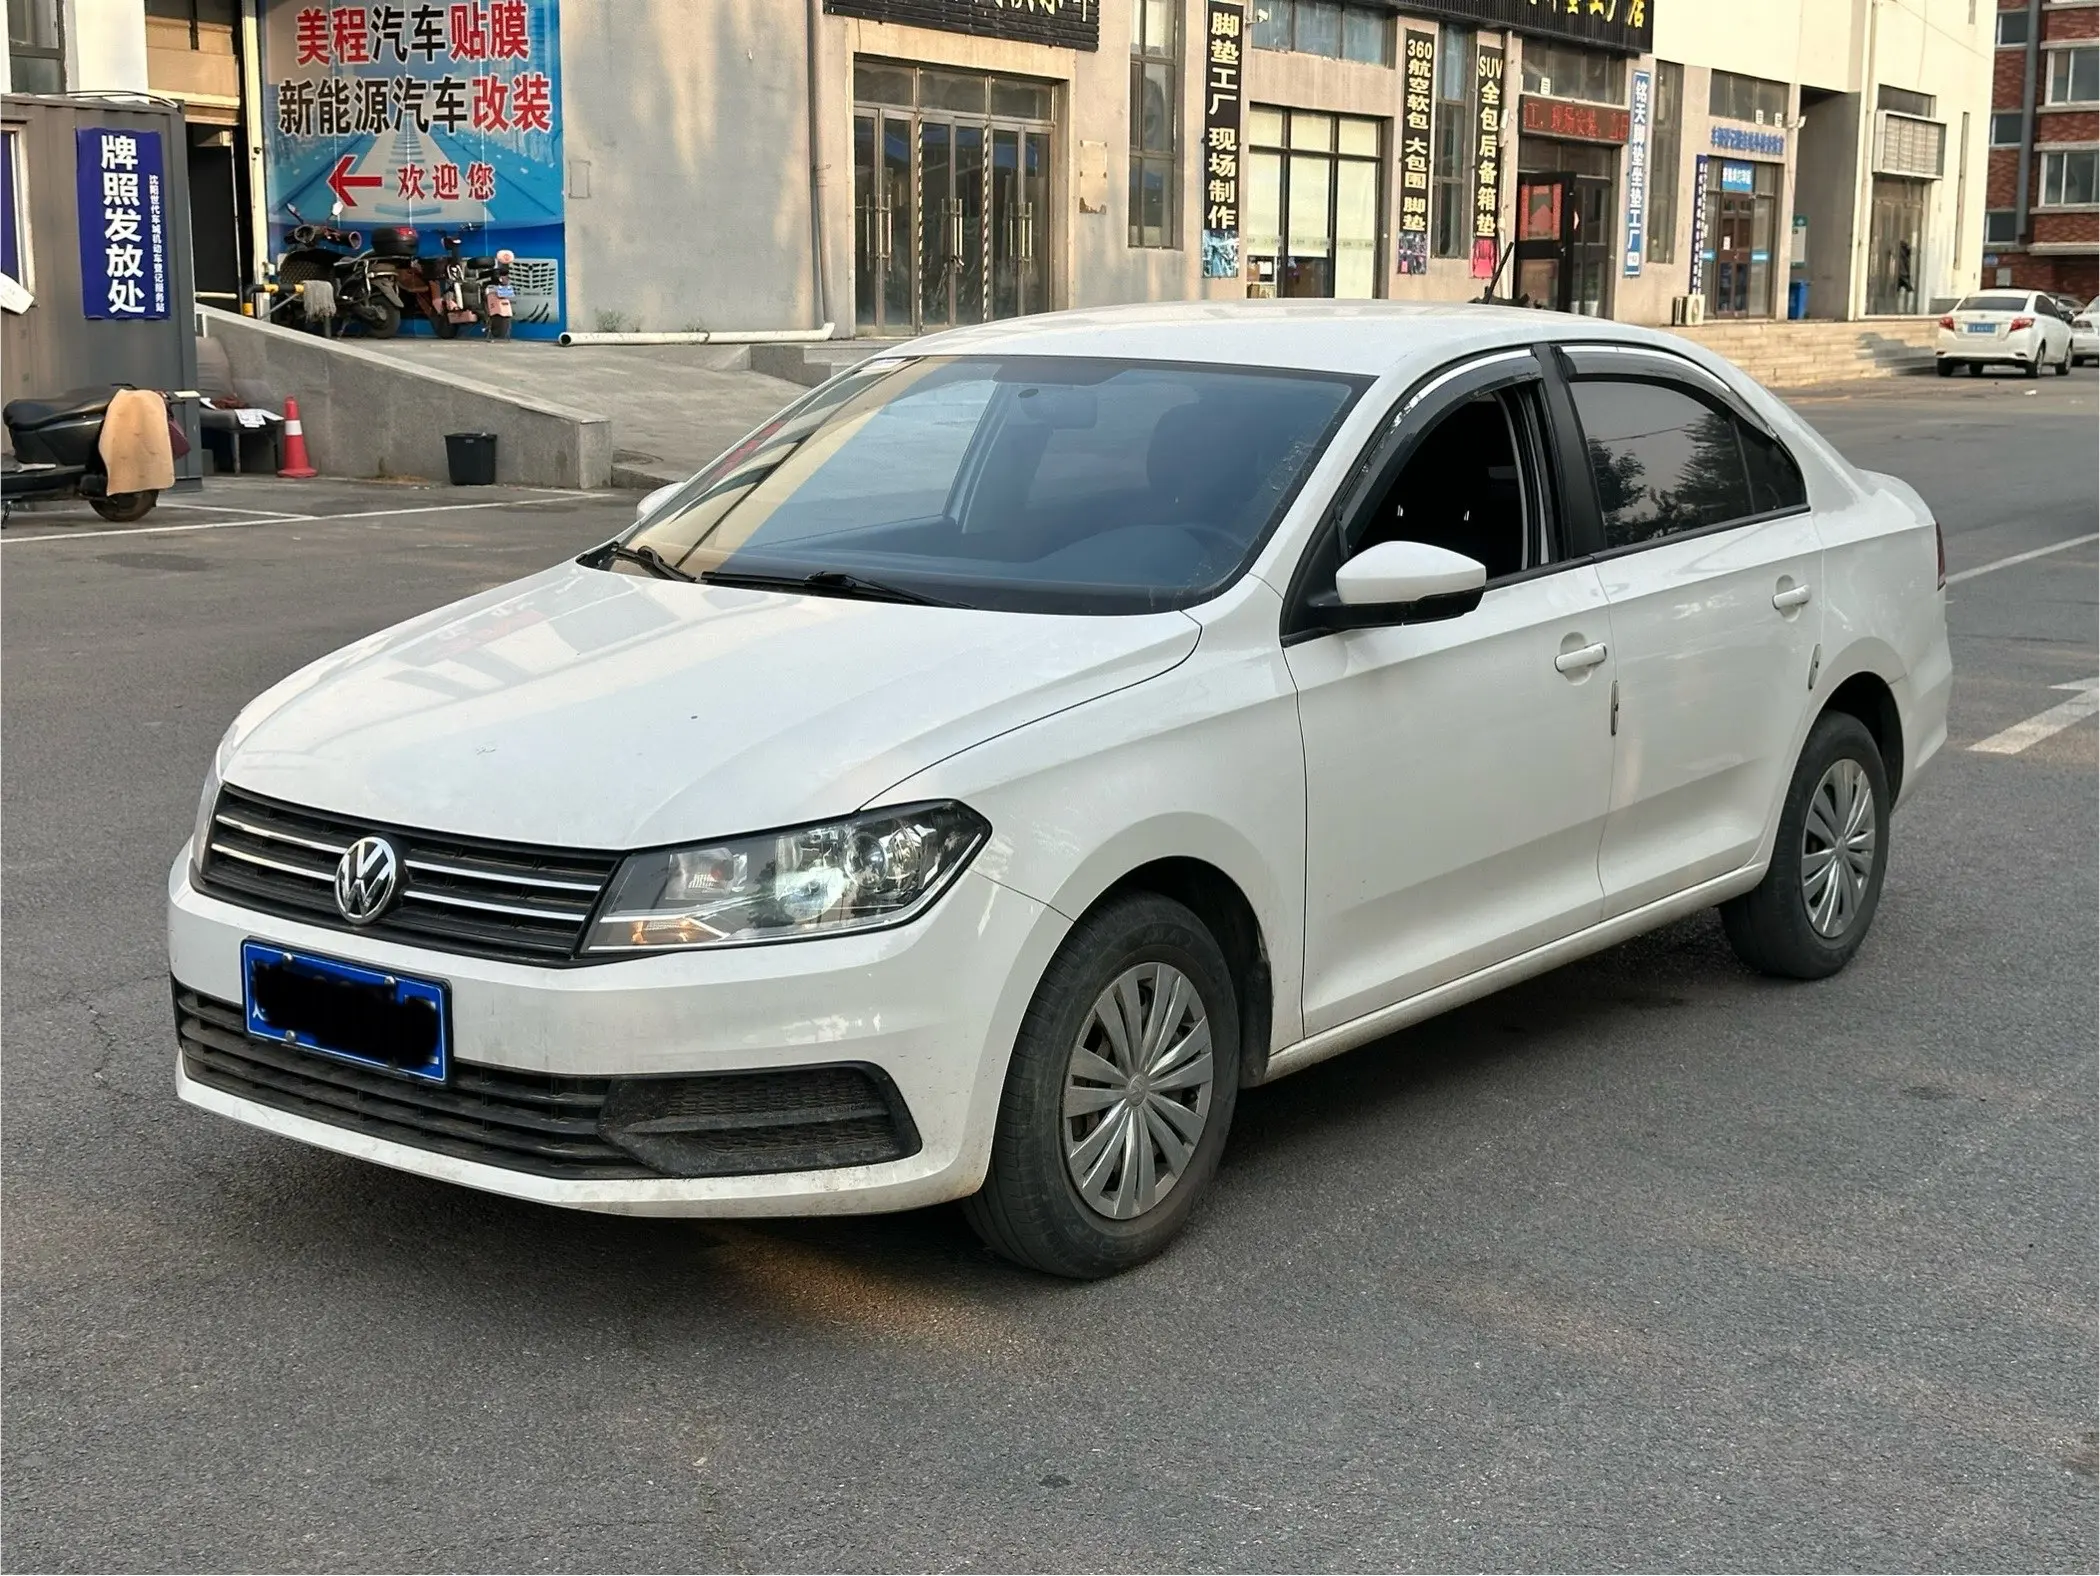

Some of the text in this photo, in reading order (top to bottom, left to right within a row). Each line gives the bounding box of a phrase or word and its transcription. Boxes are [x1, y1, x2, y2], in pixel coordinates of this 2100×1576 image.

[296, 3, 530, 66] 美程汽车贴膜
[279, 73, 552, 136] 新能源汽车改装
[1208, 12, 1240, 230] 脚垫工厂 现场制作
[397, 162, 496, 200] 欢迎您
[100, 134, 146, 315] 牌照发放处
[1403, 196, 1426, 232] 脚垫
